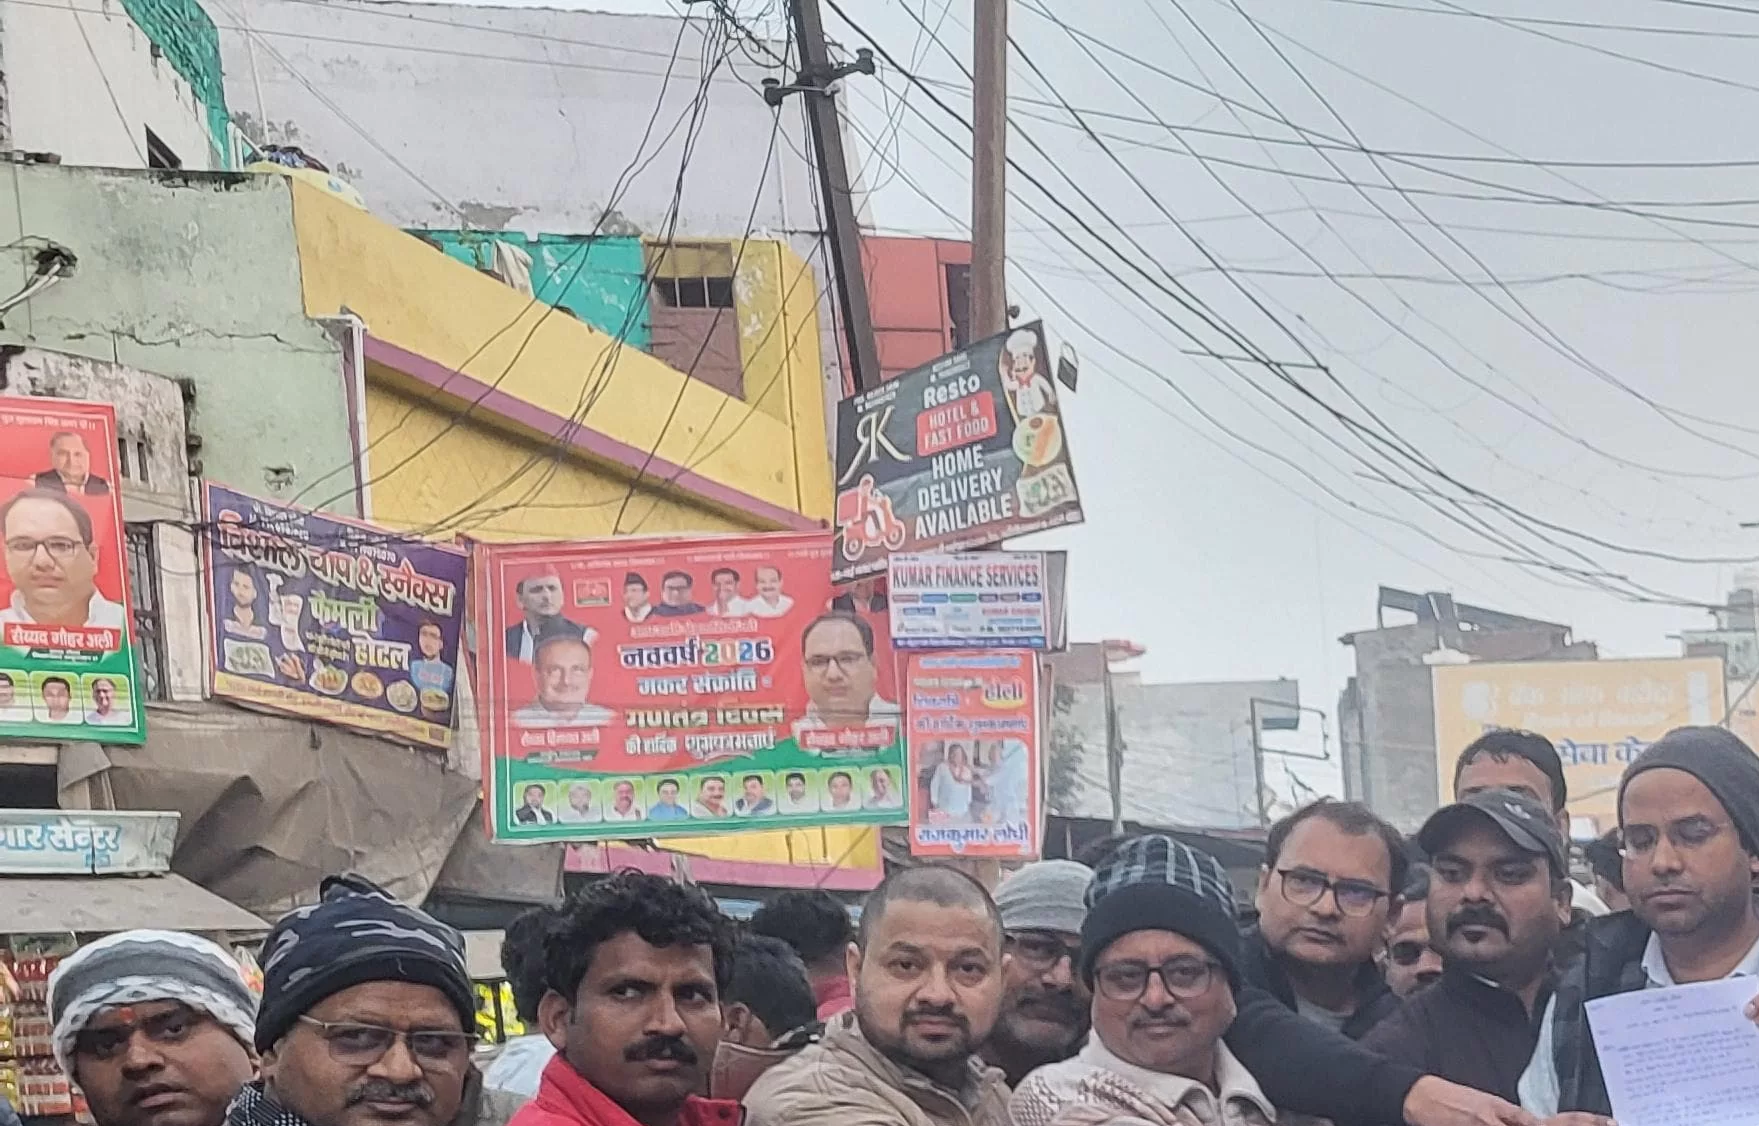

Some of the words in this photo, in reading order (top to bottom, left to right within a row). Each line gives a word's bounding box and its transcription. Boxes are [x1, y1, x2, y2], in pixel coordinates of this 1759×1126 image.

[923, 374, 981, 409] Resto
[924, 428, 954, 450] FAST
[956, 417, 989, 440] FOOD
[929, 405, 968, 428] HOTEL
[932, 444, 984, 480] HOME
[918, 468, 1003, 512] DELIVERY
[915, 493, 1014, 541] AVAILABLE
[357, 554, 379, 597] &
[893, 564, 933, 589] KUMAR
[935, 563, 983, 588] FINANCE
[986, 563, 1039, 588] SERVICES
[352, 630, 412, 671] होटल
[618, 635, 700, 668] नववर्ष
[702, 637, 774, 666] 2026
[637, 675, 689, 695] मकर
[716, 702, 786, 726] दिवस
